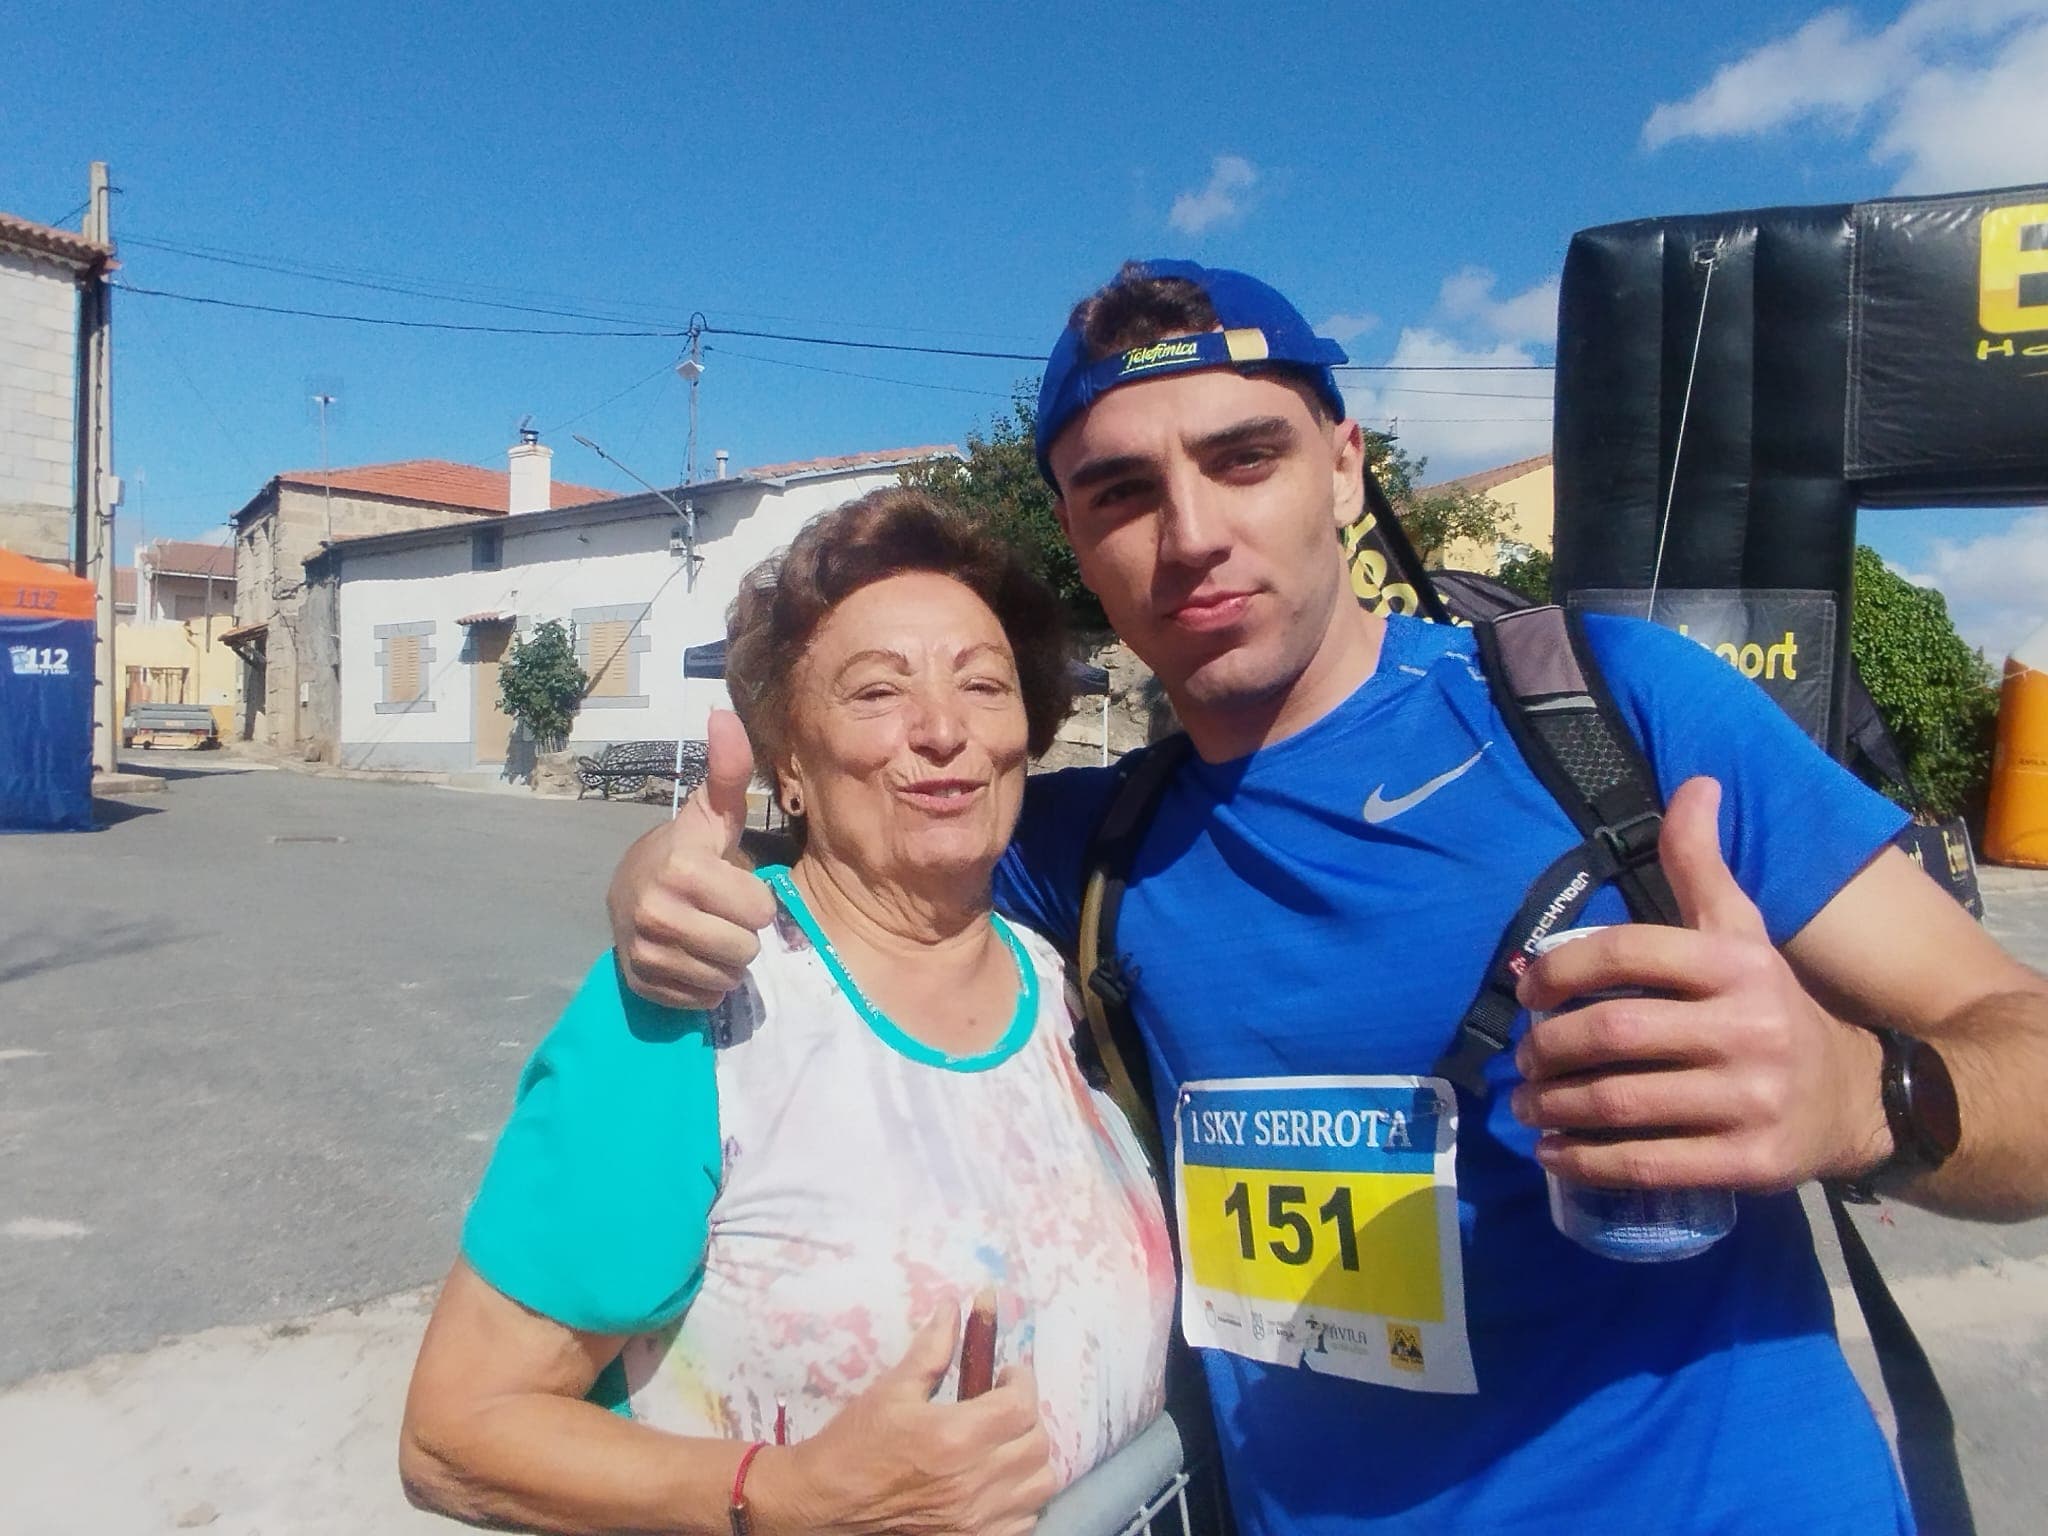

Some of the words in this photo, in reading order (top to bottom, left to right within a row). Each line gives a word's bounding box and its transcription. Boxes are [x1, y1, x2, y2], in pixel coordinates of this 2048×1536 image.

[15, 587, 58, 609] 112
[27, 647, 69, 670] 112
[1202, 1110, 1248, 1146] SKY
[1254, 1109, 1412, 1148] SERROTA
[1224, 1181, 1360, 1272] 151
